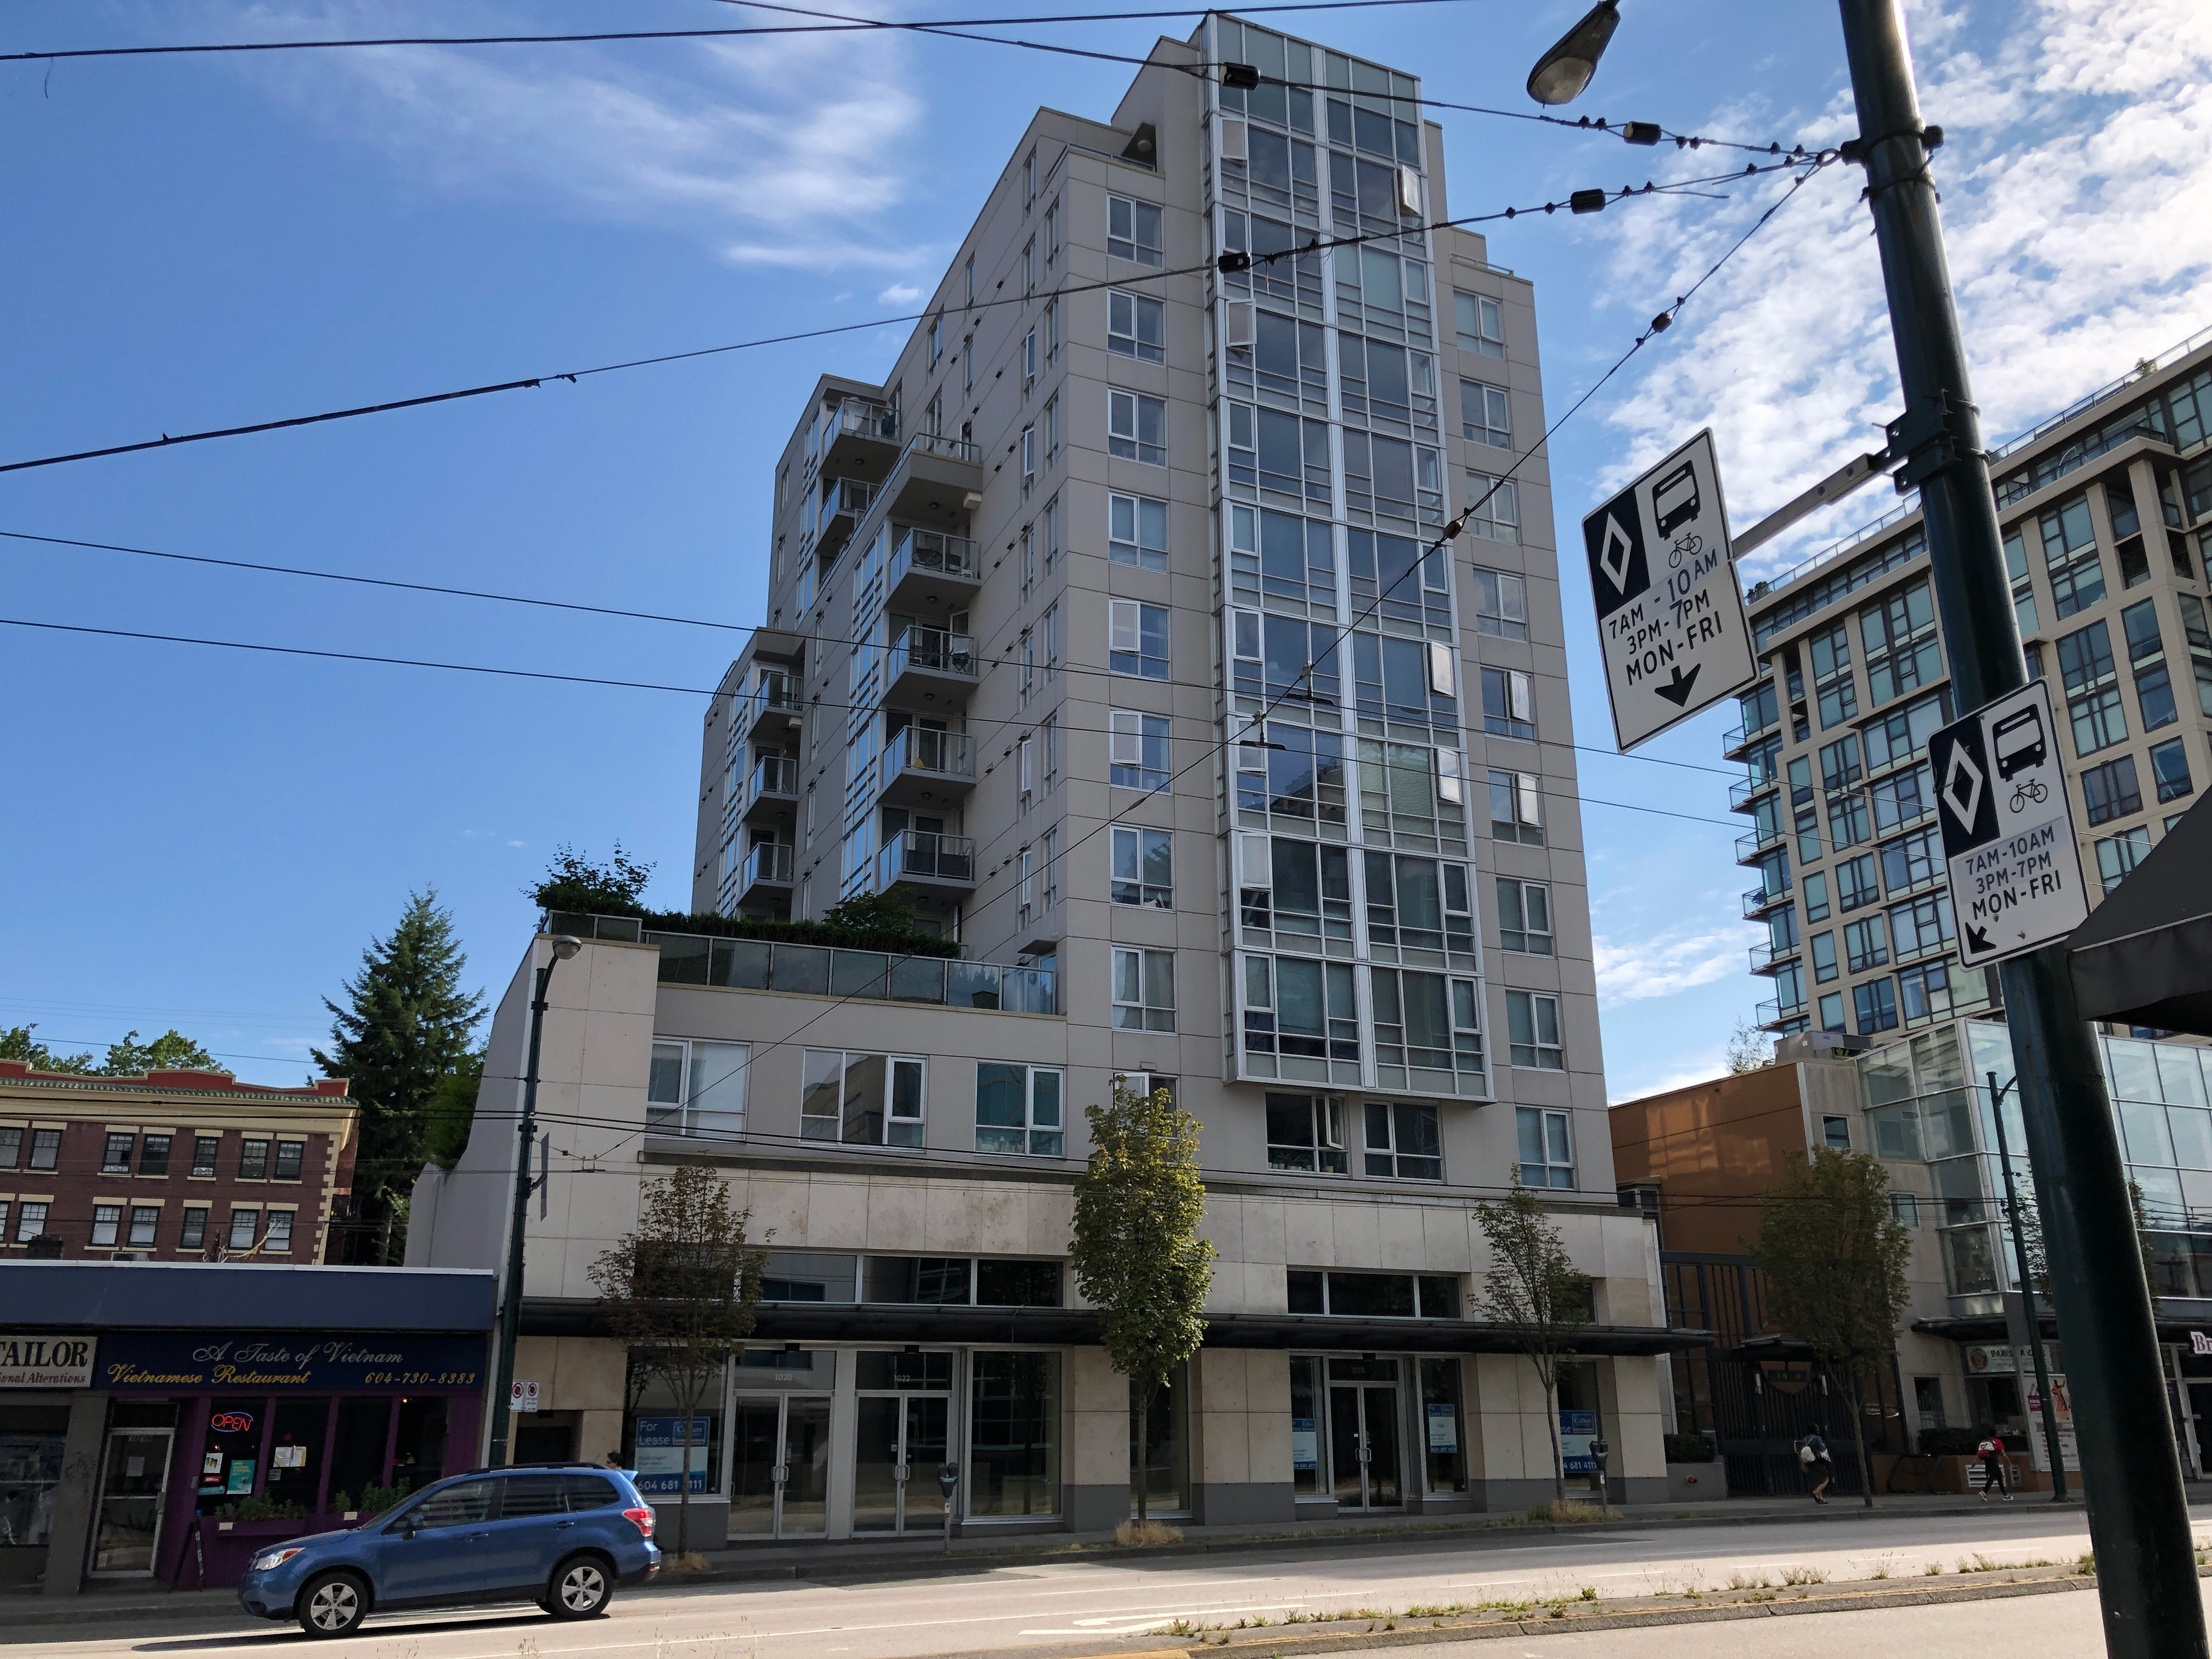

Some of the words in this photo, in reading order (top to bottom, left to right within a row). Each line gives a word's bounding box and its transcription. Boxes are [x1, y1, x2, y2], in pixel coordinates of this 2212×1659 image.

[1609, 603, 1644, 640] 7AM
[1965, 825, 2055, 876] 7AM-10AM
[1976, 850, 2052, 894] 3PM-7PM
[1972, 870, 2062, 920] MON-FRI
[193, 1341, 234, 1362] A
[234, 1343, 290, 1363] Taste
[295, 1344, 321, 1370] of
[323, 1341, 403, 1363] Vietnam
[27, 1372, 86, 1384] Alterations
[107, 1363, 203, 1384] Vietnamese
[211, 1364, 313, 1384] Restaurant
[364, 1372, 476, 1384] 604-730-8383
[775, 1373, 793, 1381] 1020
[212, 1413, 252, 1431] OPEN
[640, 1420, 658, 1432] For
[639, 1434, 670, 1445] Lease
[1570, 1462, 1582, 1470] 681
[661, 1480, 679, 1490] 681
